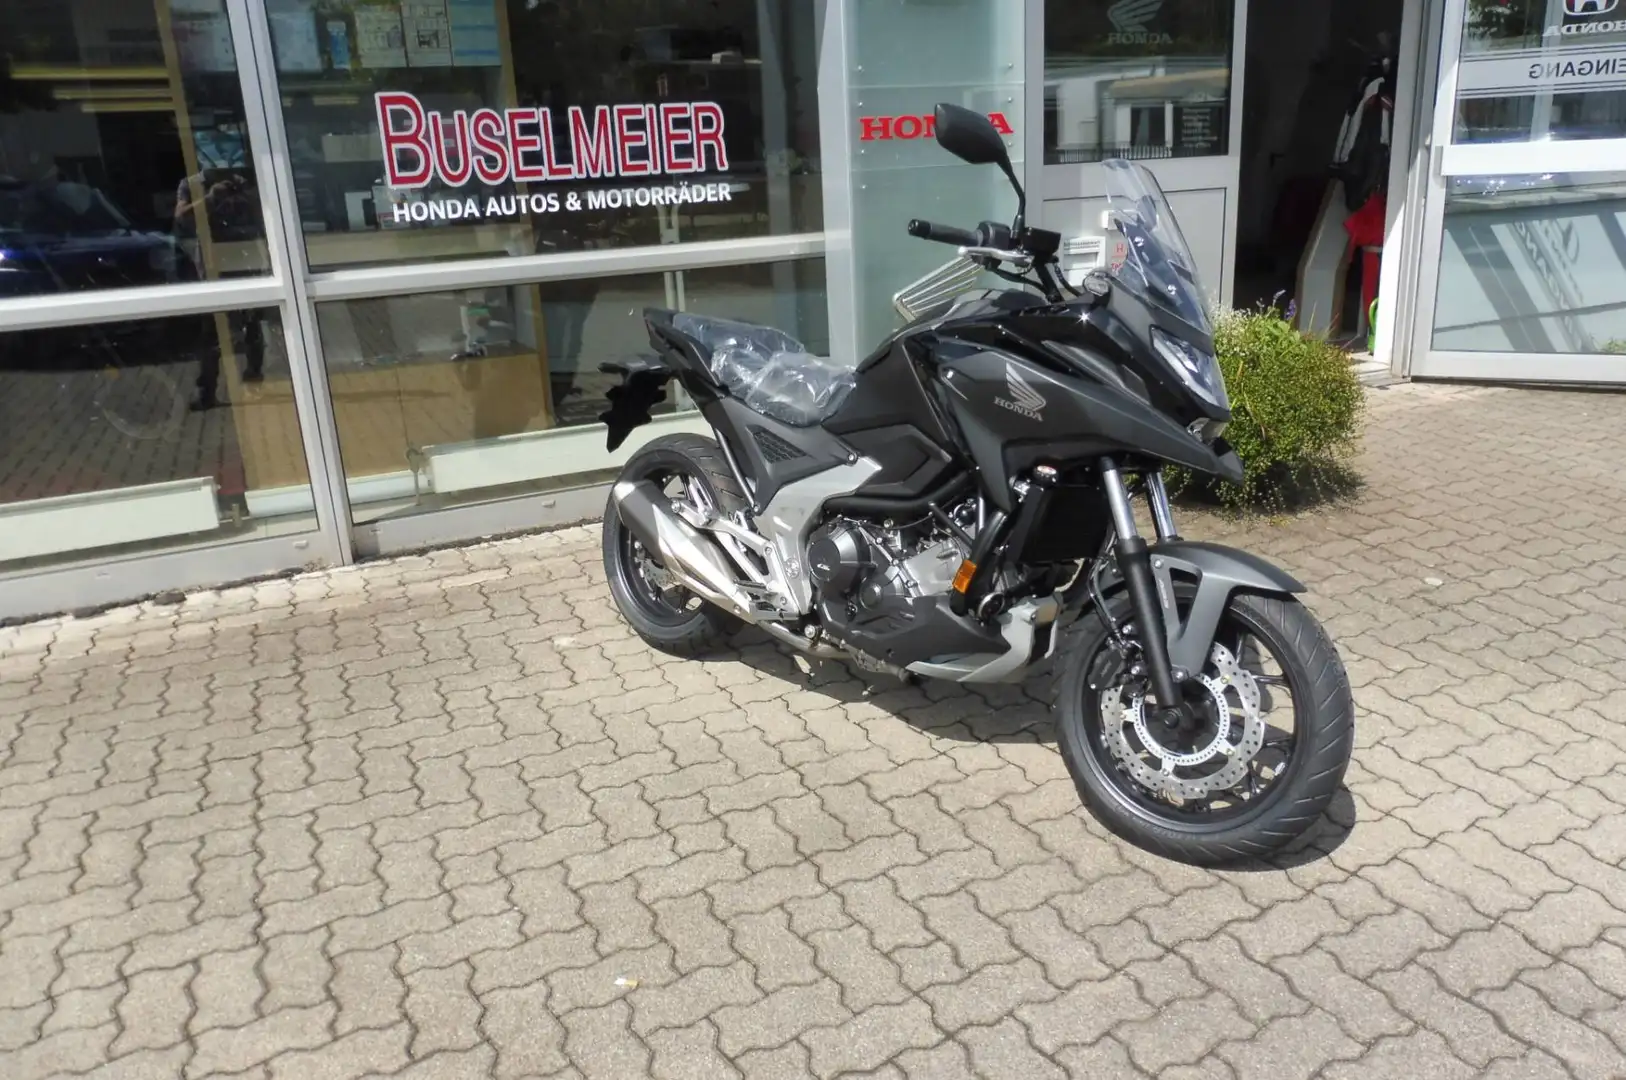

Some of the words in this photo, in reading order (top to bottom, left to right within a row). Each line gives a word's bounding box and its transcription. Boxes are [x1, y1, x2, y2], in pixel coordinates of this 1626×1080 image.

[1107, 32, 1173, 44] HONDA
[374, 91, 729, 189] BUSELMEIER
[859, 112, 1014, 141] HOA
[392, 197, 480, 223] HONDA
[485, 192, 560, 217] AUTOS
[564, 191, 582, 211] &
[587, 181, 732, 210] MOTORRÄDER
[993, 395, 1043, 422] HONDA
